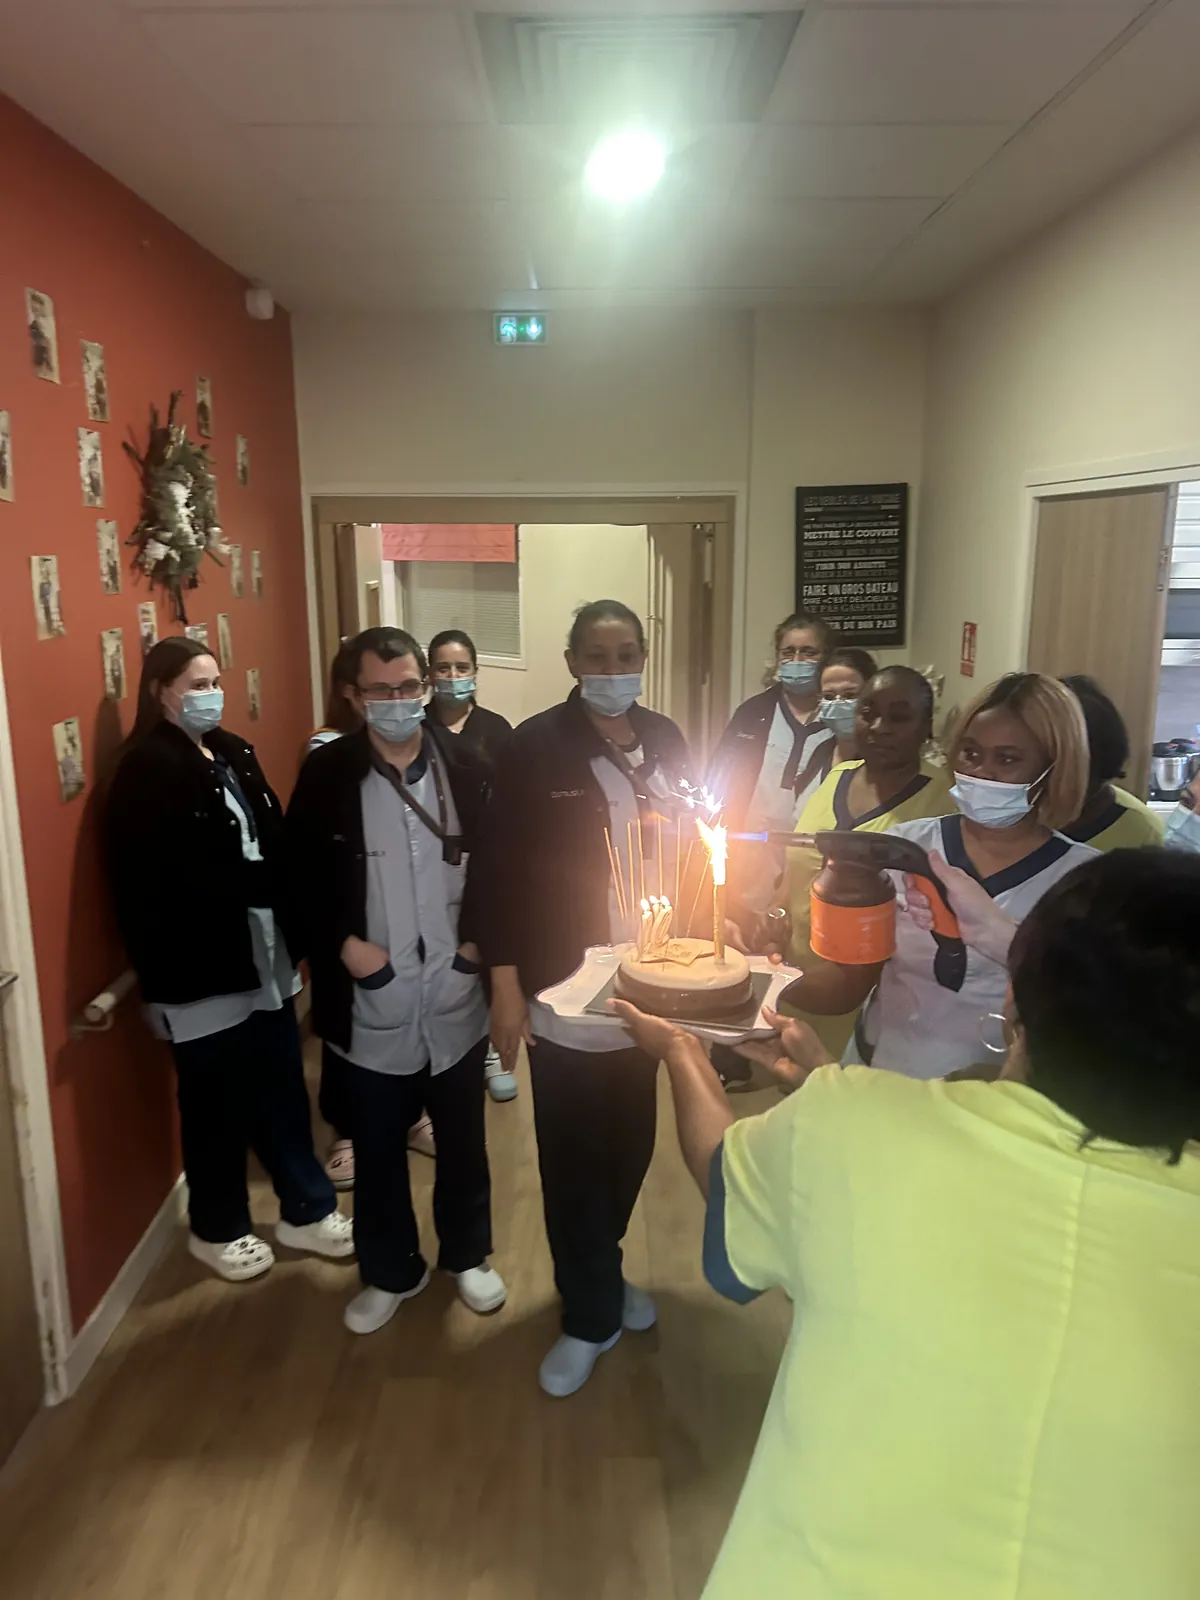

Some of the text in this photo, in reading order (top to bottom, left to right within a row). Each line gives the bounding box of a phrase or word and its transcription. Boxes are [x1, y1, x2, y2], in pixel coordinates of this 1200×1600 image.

[804, 528, 900, 540] METTRE LE COUVERT
[803, 584, 828, 596] FAIRE
[828, 584, 840, 596] UN
[842, 583, 865, 596] GROS
[876, 620, 897, 628] PAIN
